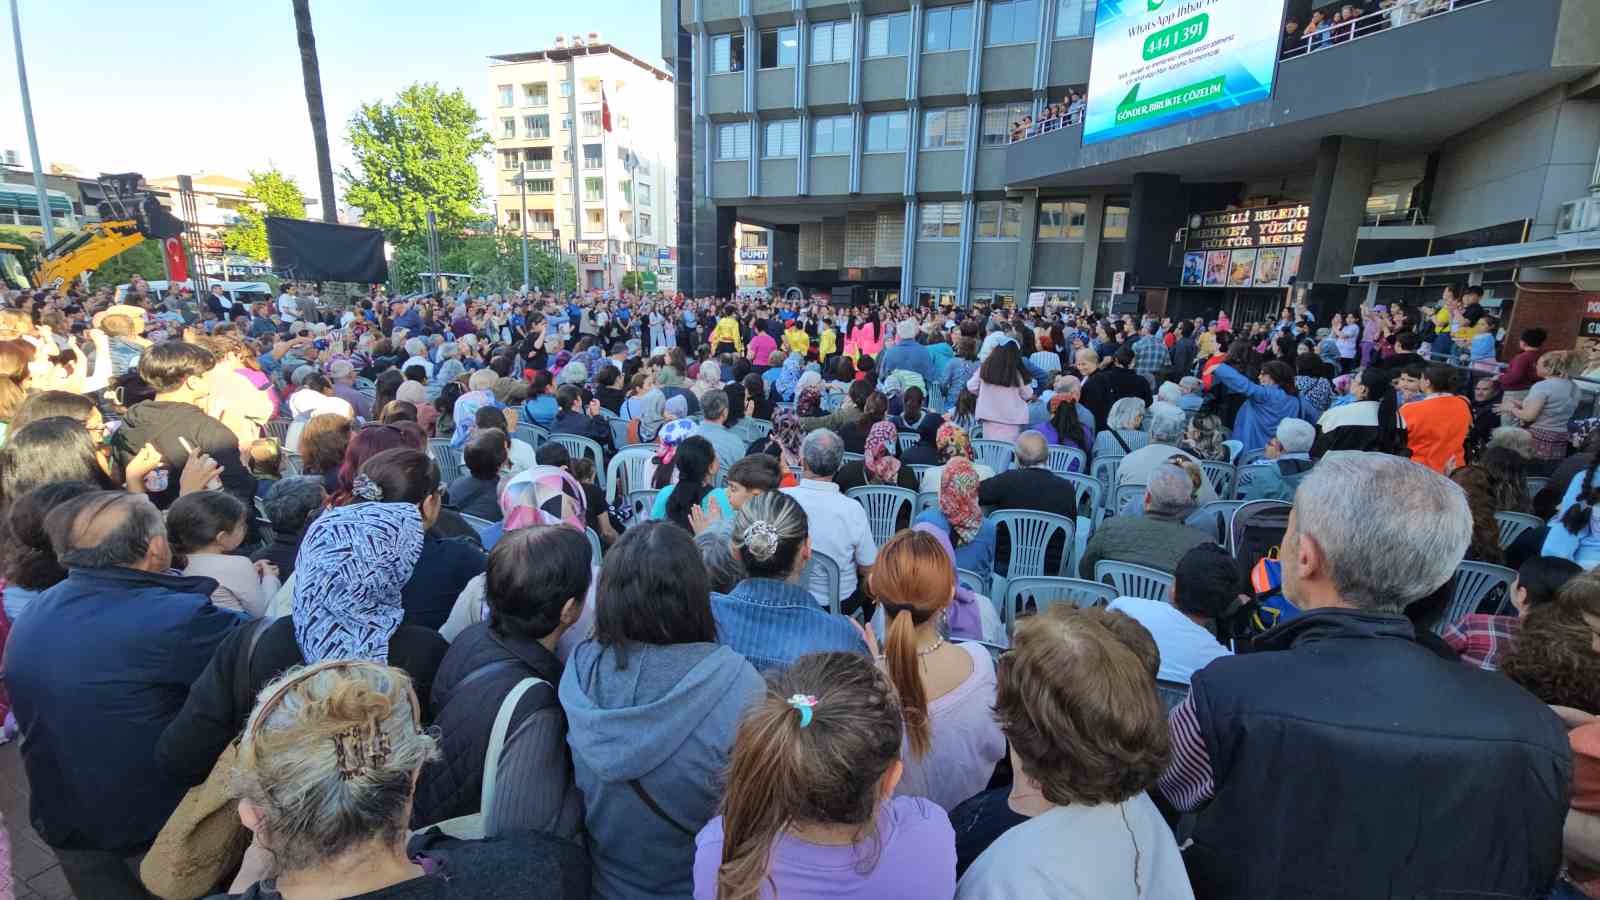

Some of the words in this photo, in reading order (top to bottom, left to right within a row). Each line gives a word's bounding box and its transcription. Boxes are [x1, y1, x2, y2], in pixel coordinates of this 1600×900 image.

[1128, 12, 1175, 38] WhatsApp
[1148, 33, 1170, 54] 444
[1173, 31, 1179, 45] 1
[1182, 21, 1204, 42] 391
[1183, 82, 1222, 104] ÇÖZELİM
